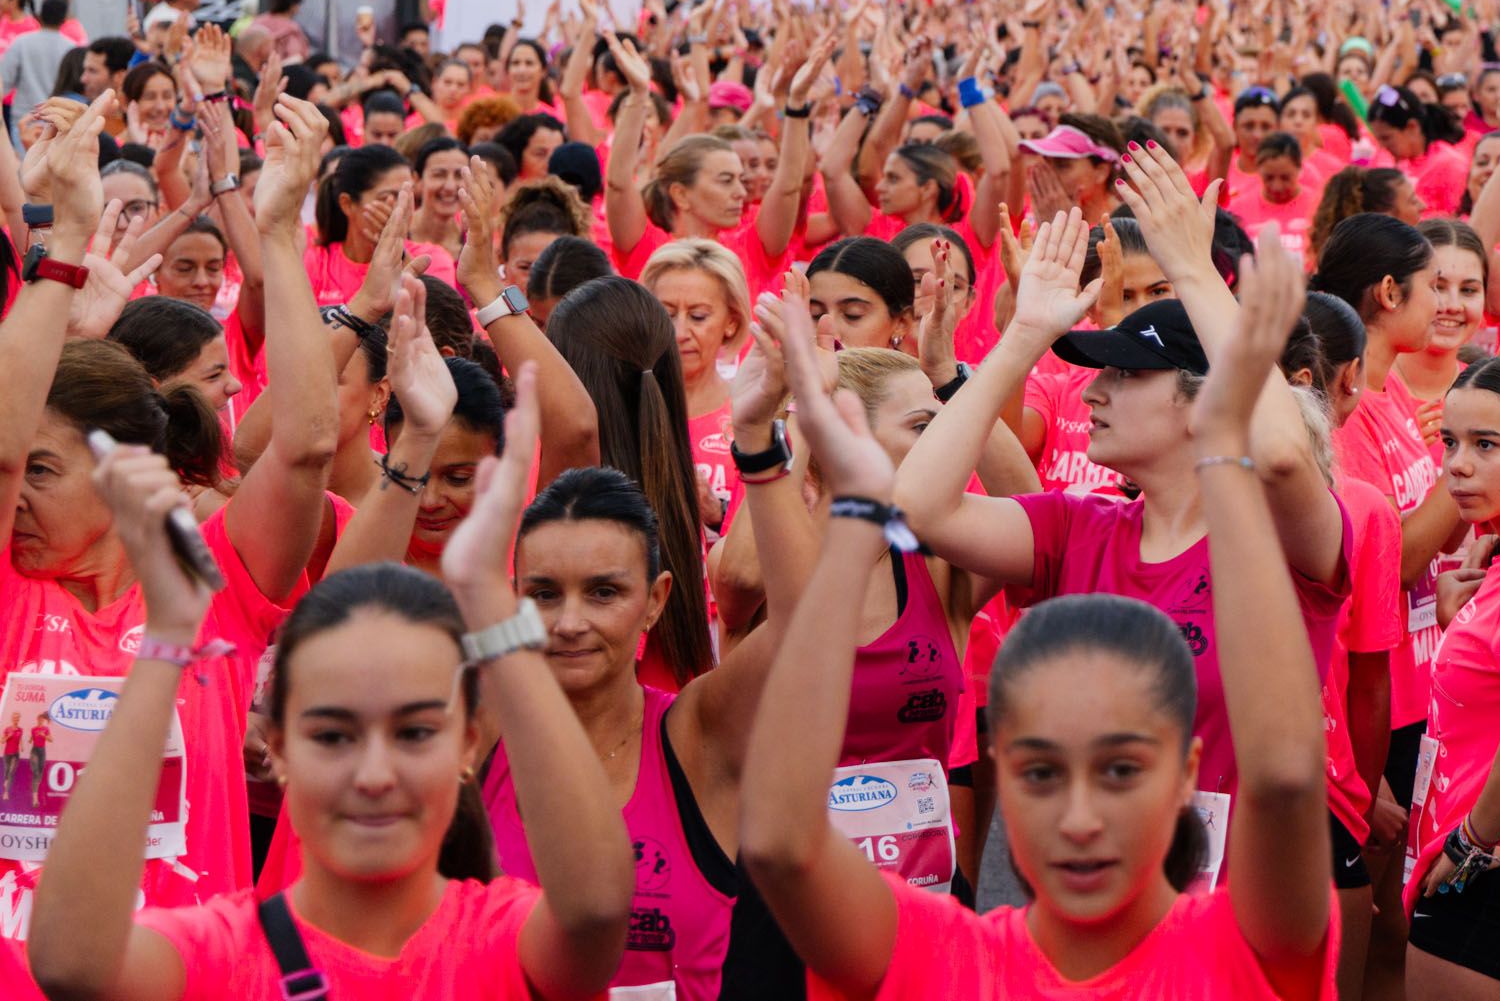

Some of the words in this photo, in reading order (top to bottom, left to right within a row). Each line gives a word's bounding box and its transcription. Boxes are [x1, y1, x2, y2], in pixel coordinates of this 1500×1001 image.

[15, 691, 46, 704] SUMA
[829, 789, 893, 806] ASTURIANA
[0, 812, 42, 826] CARRERA
[44, 816, 58, 826] DE
[1, 834, 48, 850] OYSH
[858, 835, 900, 862] 16
